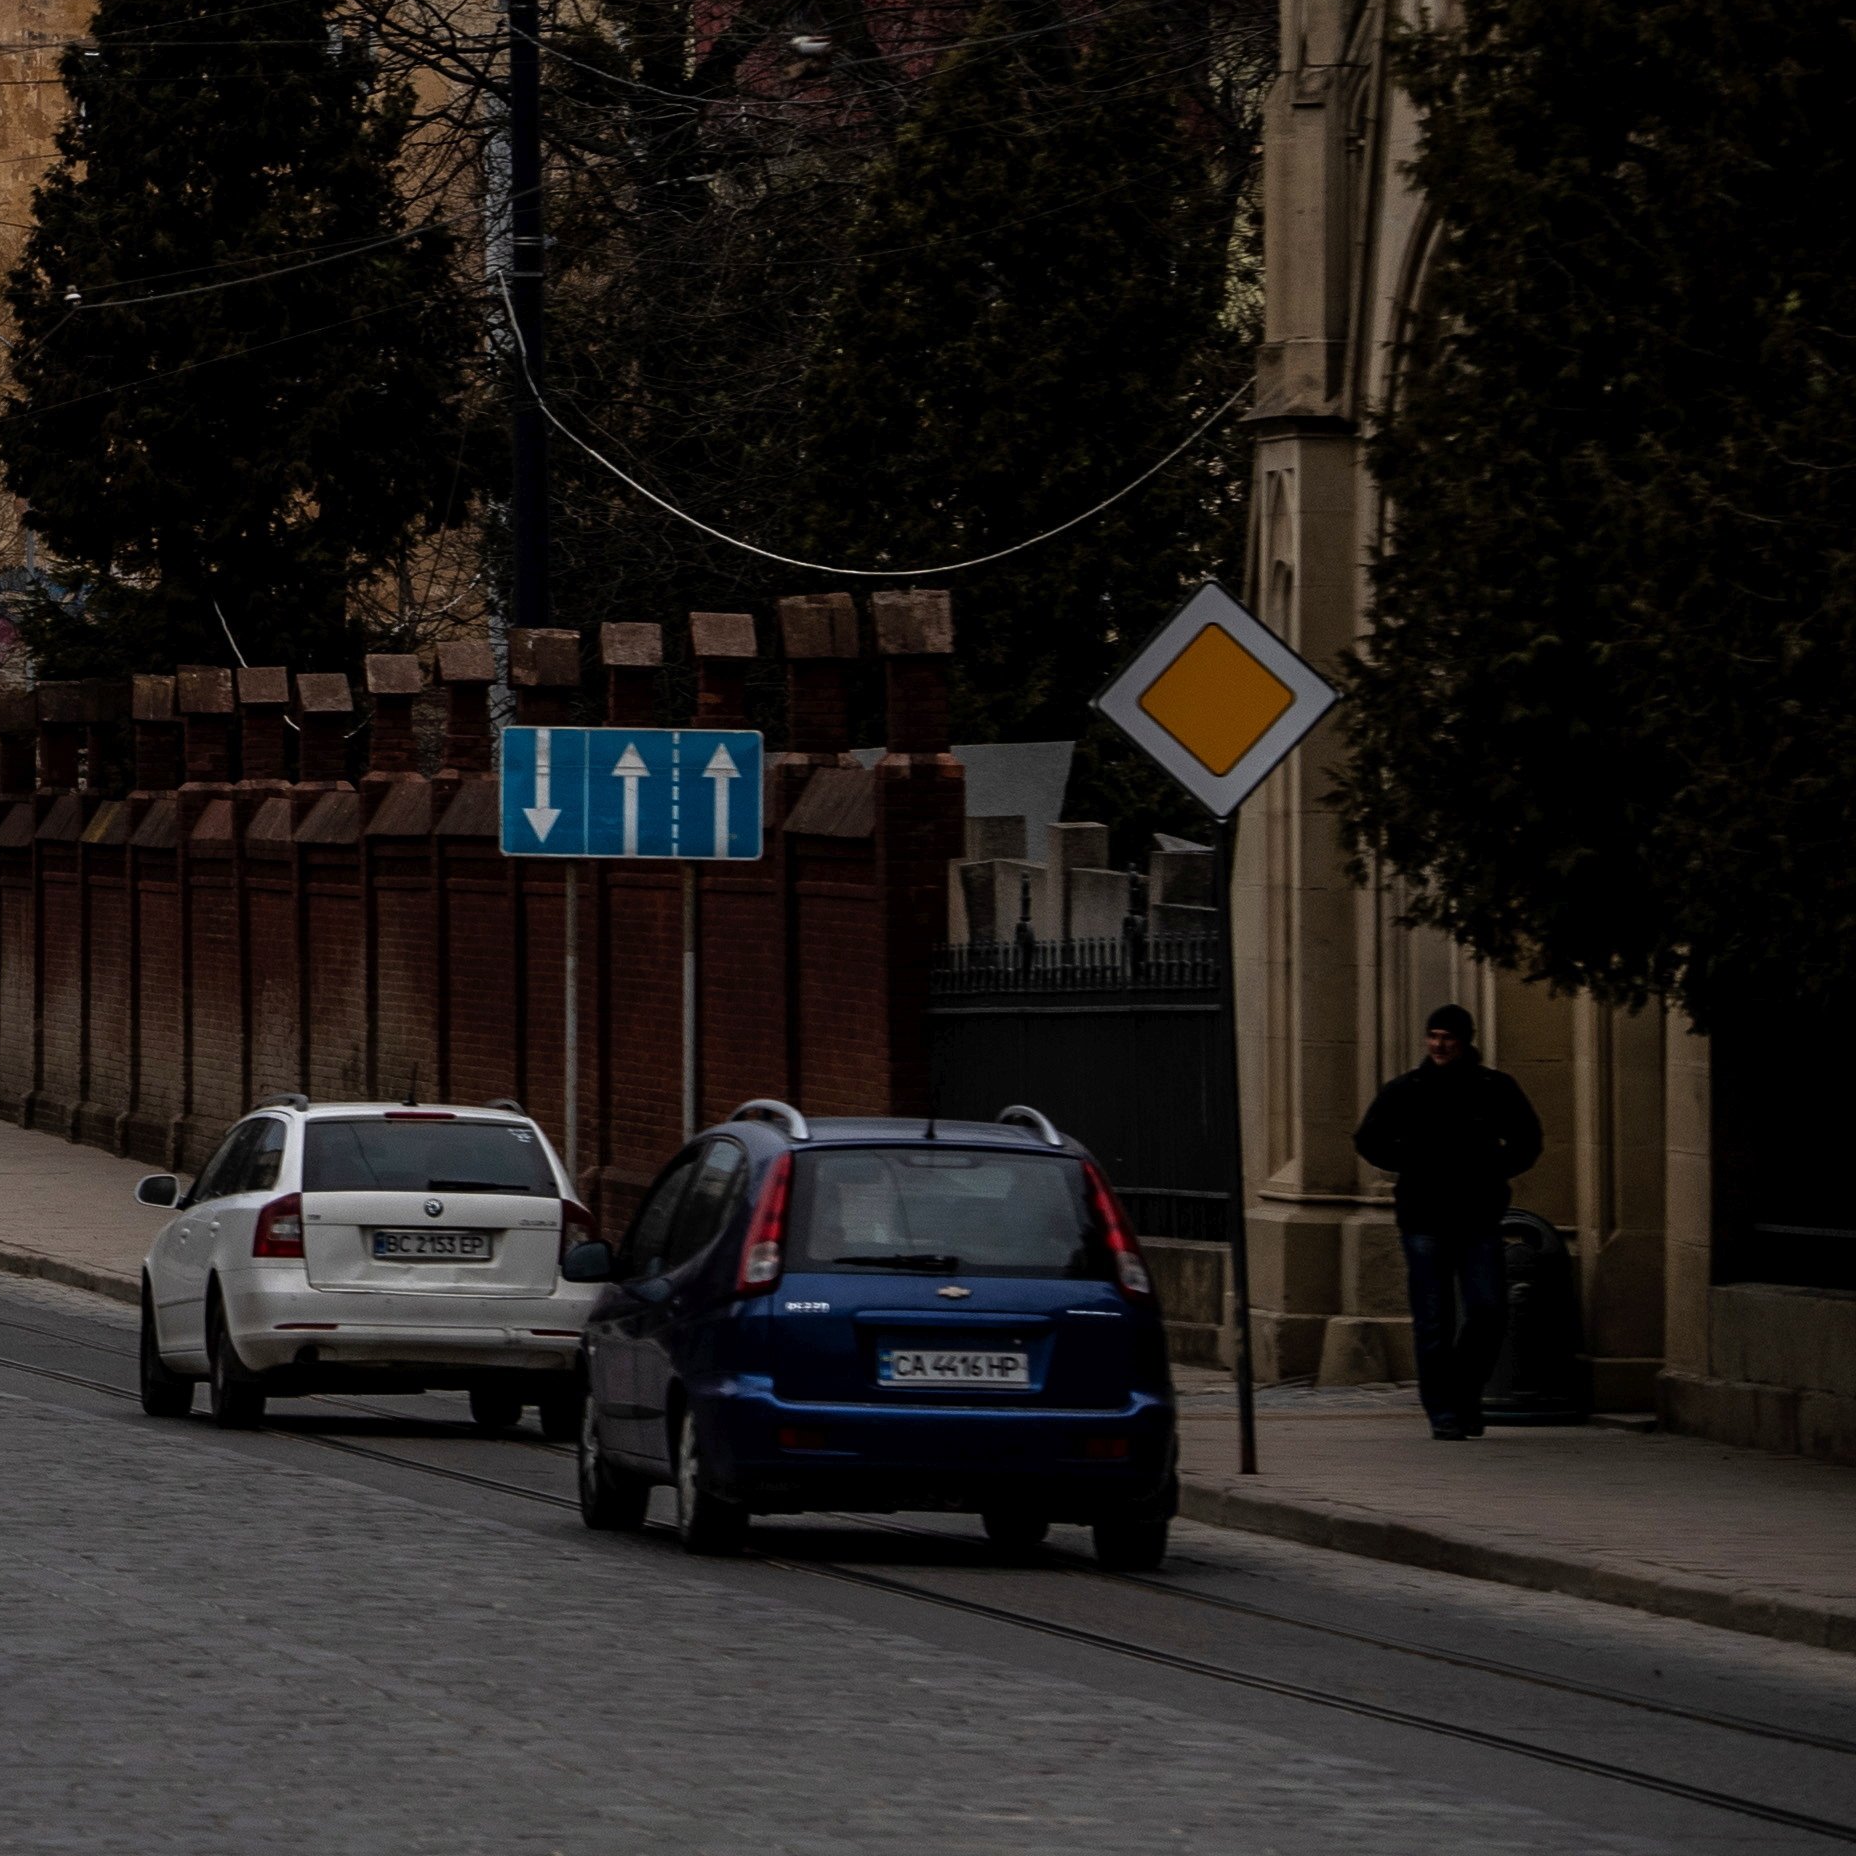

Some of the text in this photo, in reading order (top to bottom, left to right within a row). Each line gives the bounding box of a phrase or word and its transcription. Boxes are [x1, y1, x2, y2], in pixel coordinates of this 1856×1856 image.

[388, 1235, 485, 1254] BC 2153 EP
[895, 1355, 1021, 1379] CA 4416 HP
